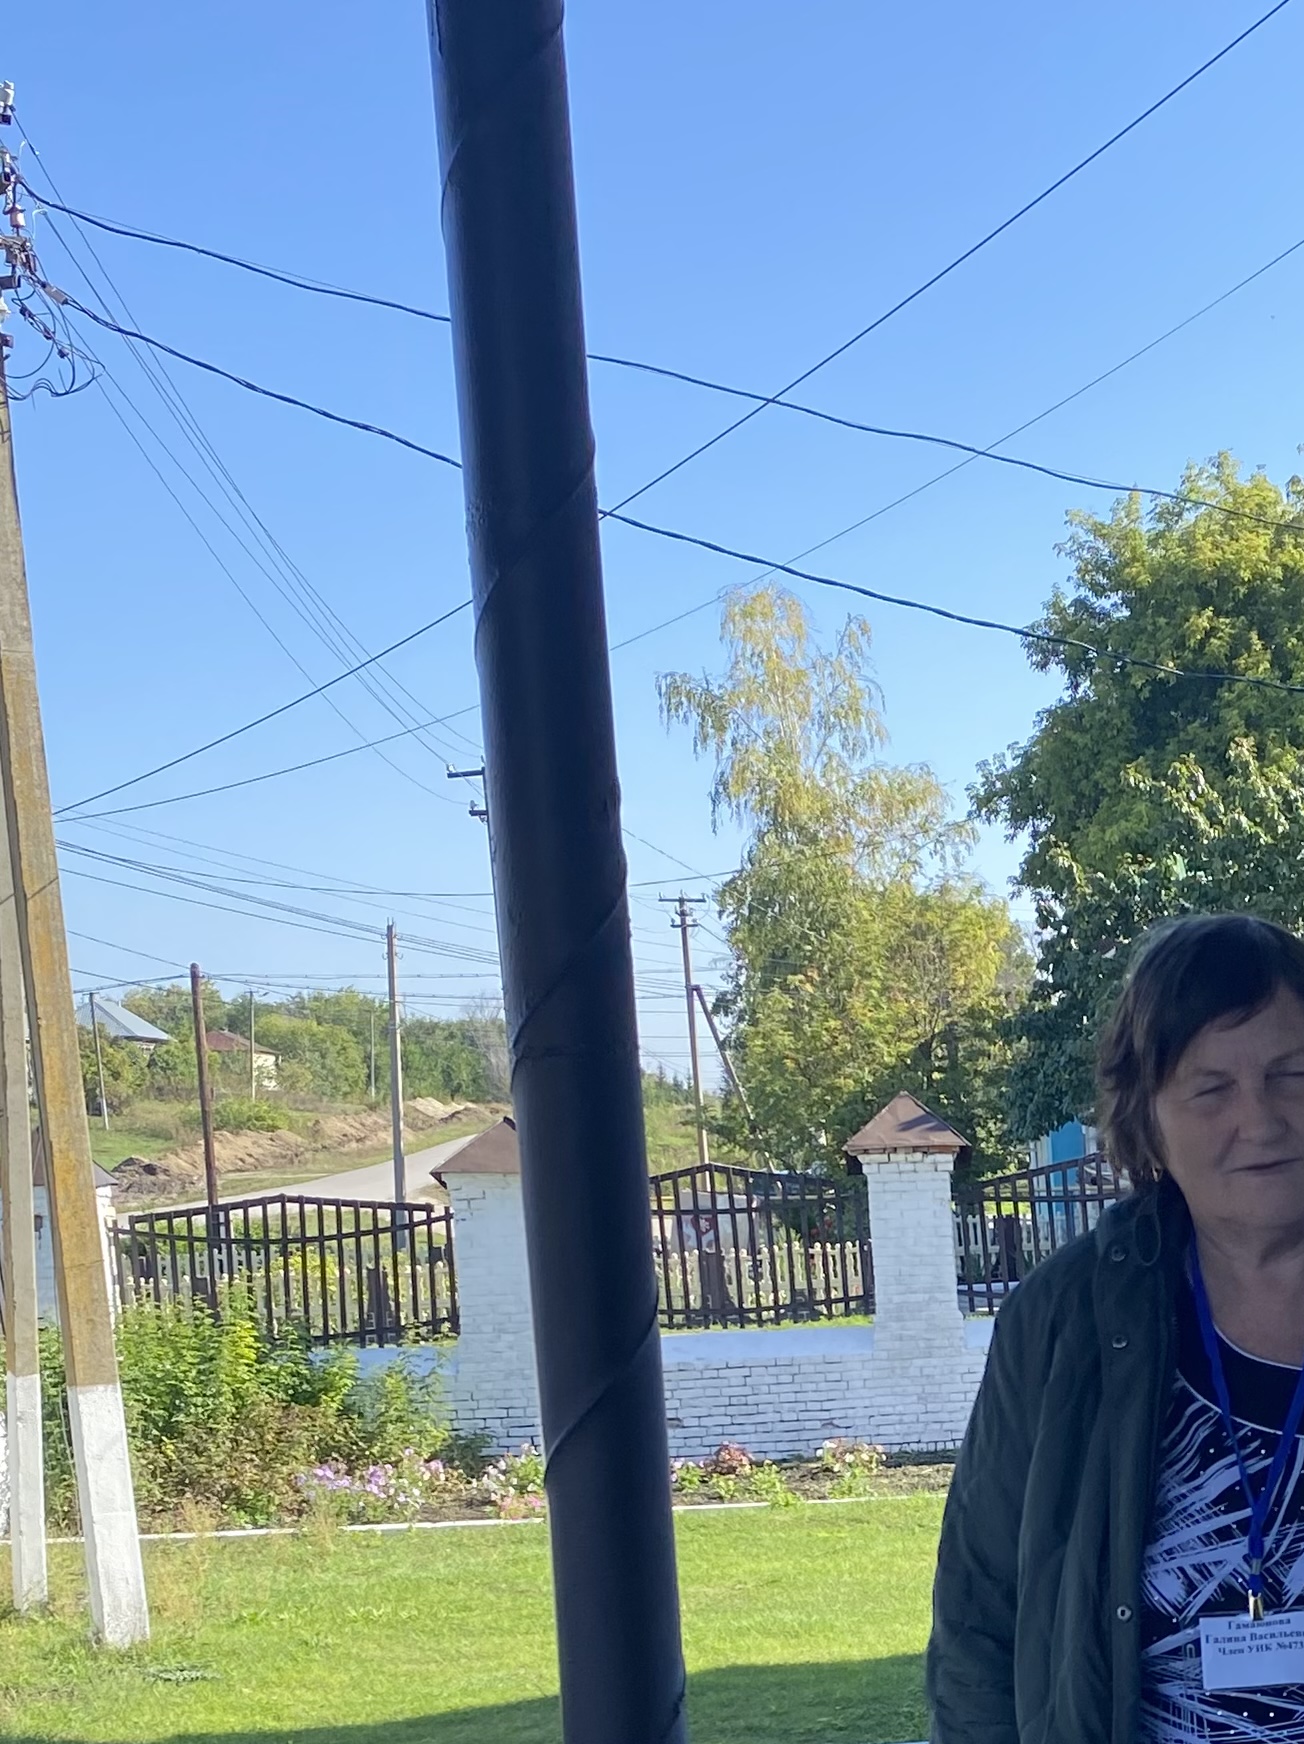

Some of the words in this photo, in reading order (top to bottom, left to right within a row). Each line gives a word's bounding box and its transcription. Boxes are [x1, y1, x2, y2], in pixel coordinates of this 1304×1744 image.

[1205, 1633, 1247, 1644] Галина
[1218, 1646, 1245, 1656] Член
[1247, 1643, 1273, 1654] УИК
